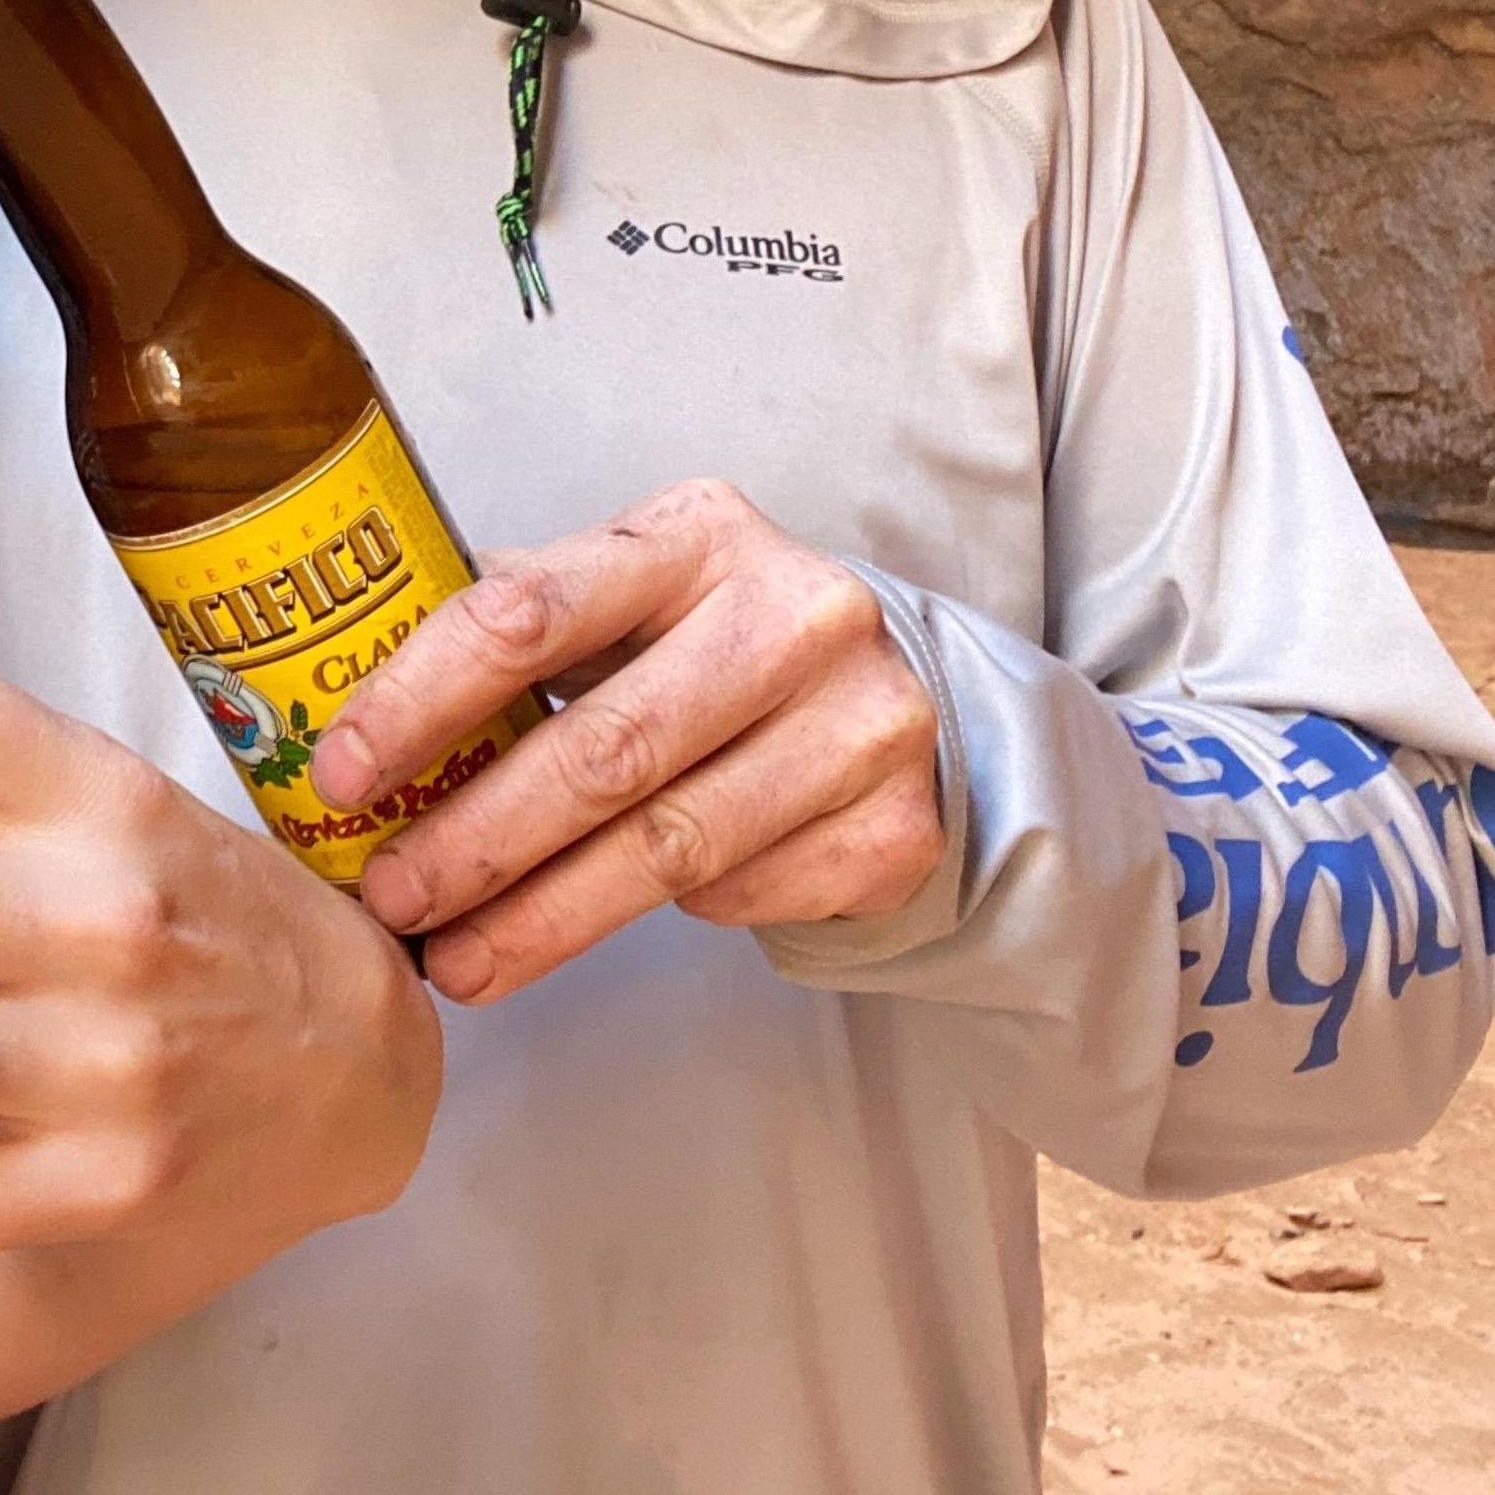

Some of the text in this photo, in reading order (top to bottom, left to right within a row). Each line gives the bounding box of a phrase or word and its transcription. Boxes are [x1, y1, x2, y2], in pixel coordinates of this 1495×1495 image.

[653, 222, 842, 267] Columbia
[726, 260, 844, 282] PFG
[176, 482, 370, 590] CERVEZA
